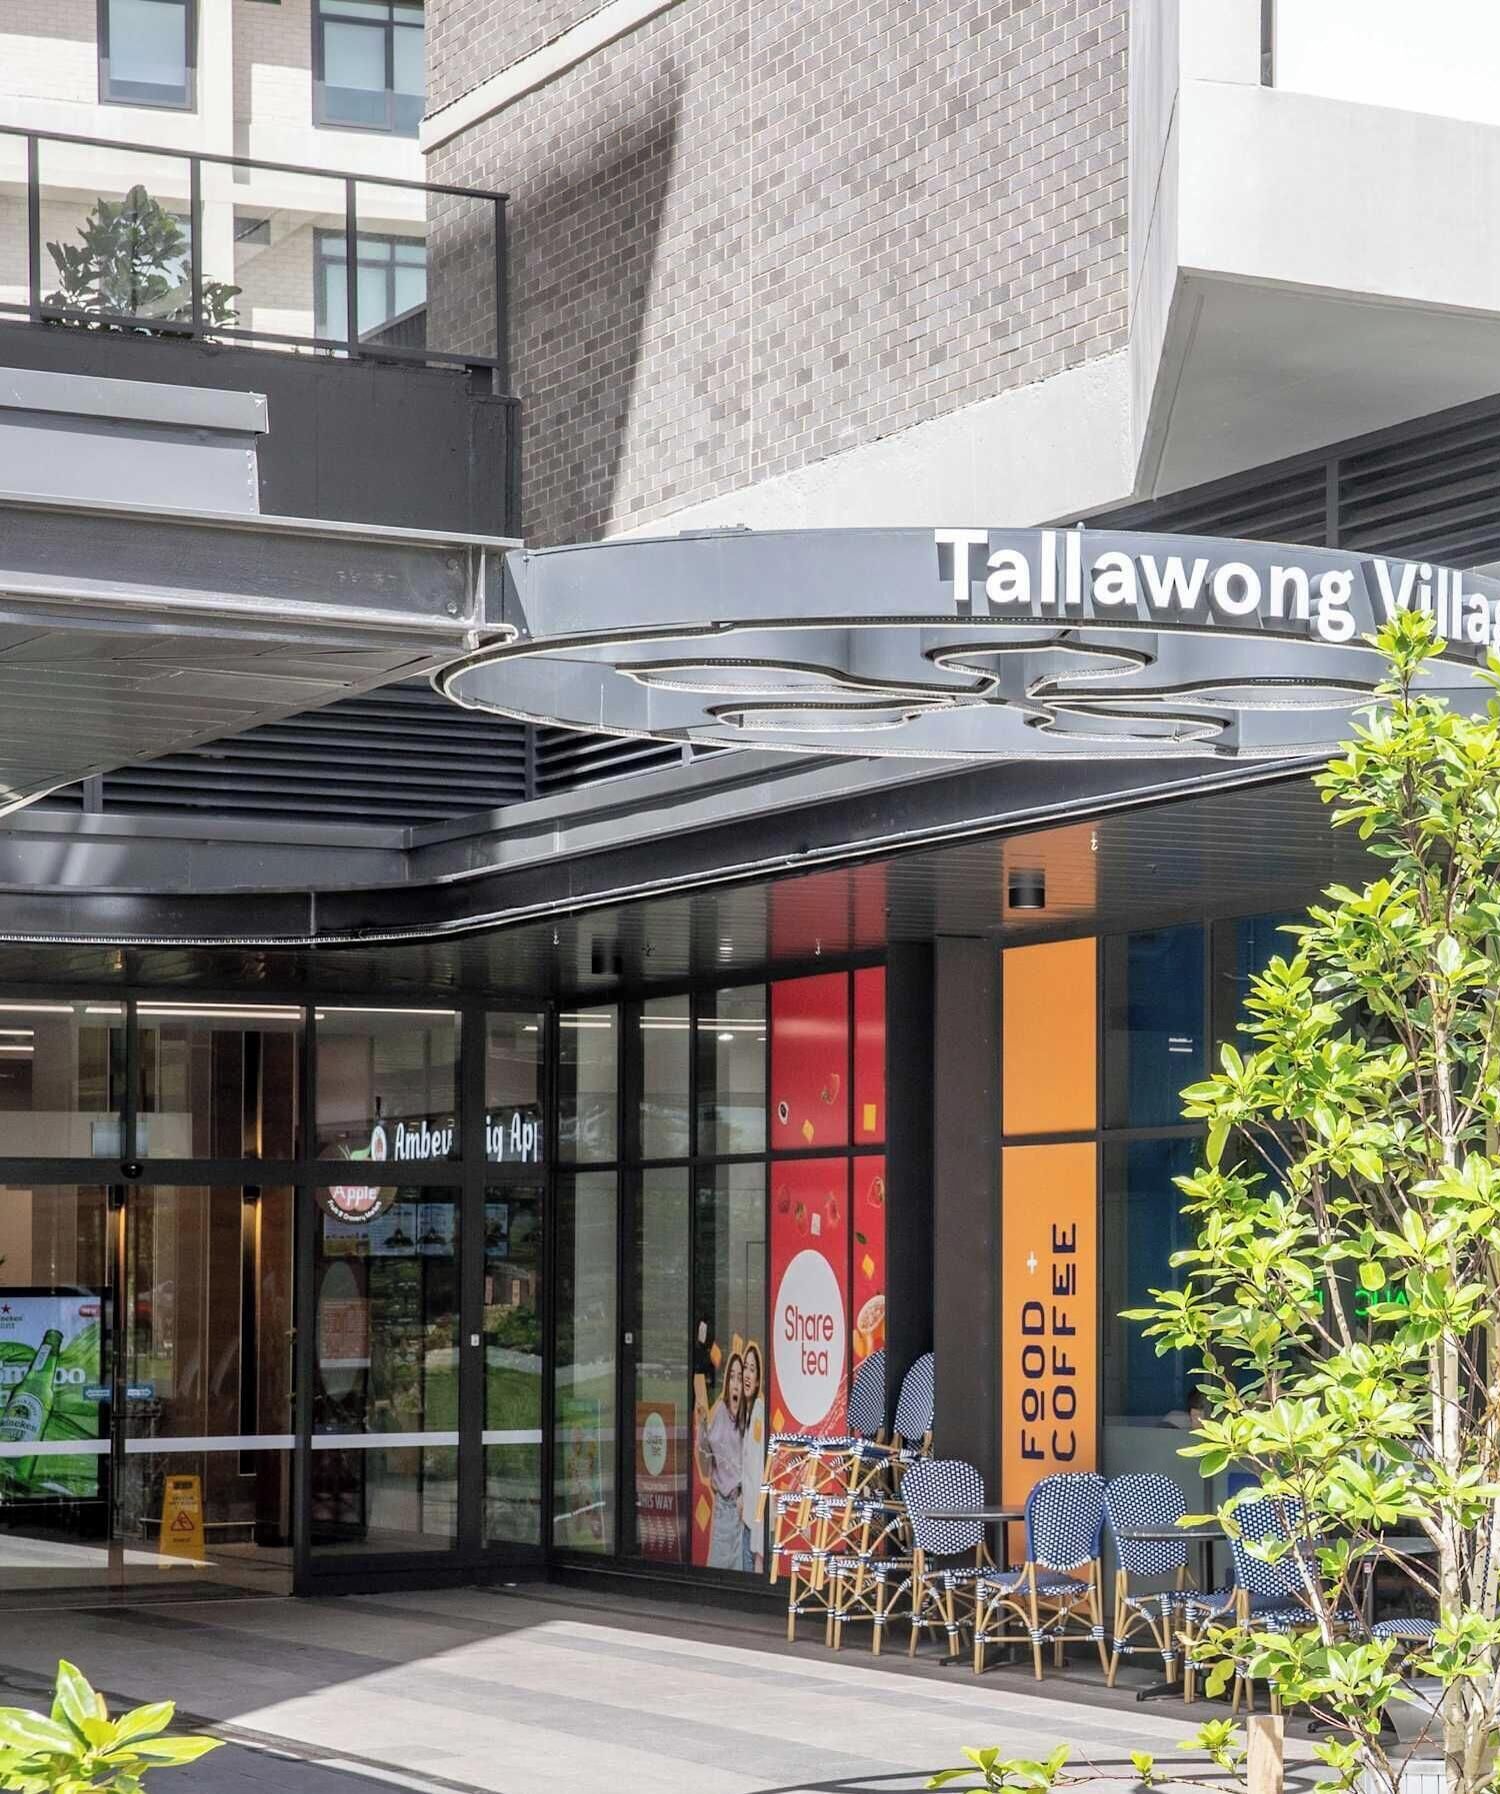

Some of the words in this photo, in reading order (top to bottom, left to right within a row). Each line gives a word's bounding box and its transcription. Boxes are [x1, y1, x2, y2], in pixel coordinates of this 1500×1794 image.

[934, 528, 1356, 644] Tallawong
[332, 1186, 377, 1207] Apple
[784, 1304, 834, 1342] Share
[801, 1342, 829, 1377] tea
[1051, 1222, 1077, 1463] COFFEE
[1020, 1300, 1046, 1461] FOOD
[654, 1495, 674, 1511] WAY
